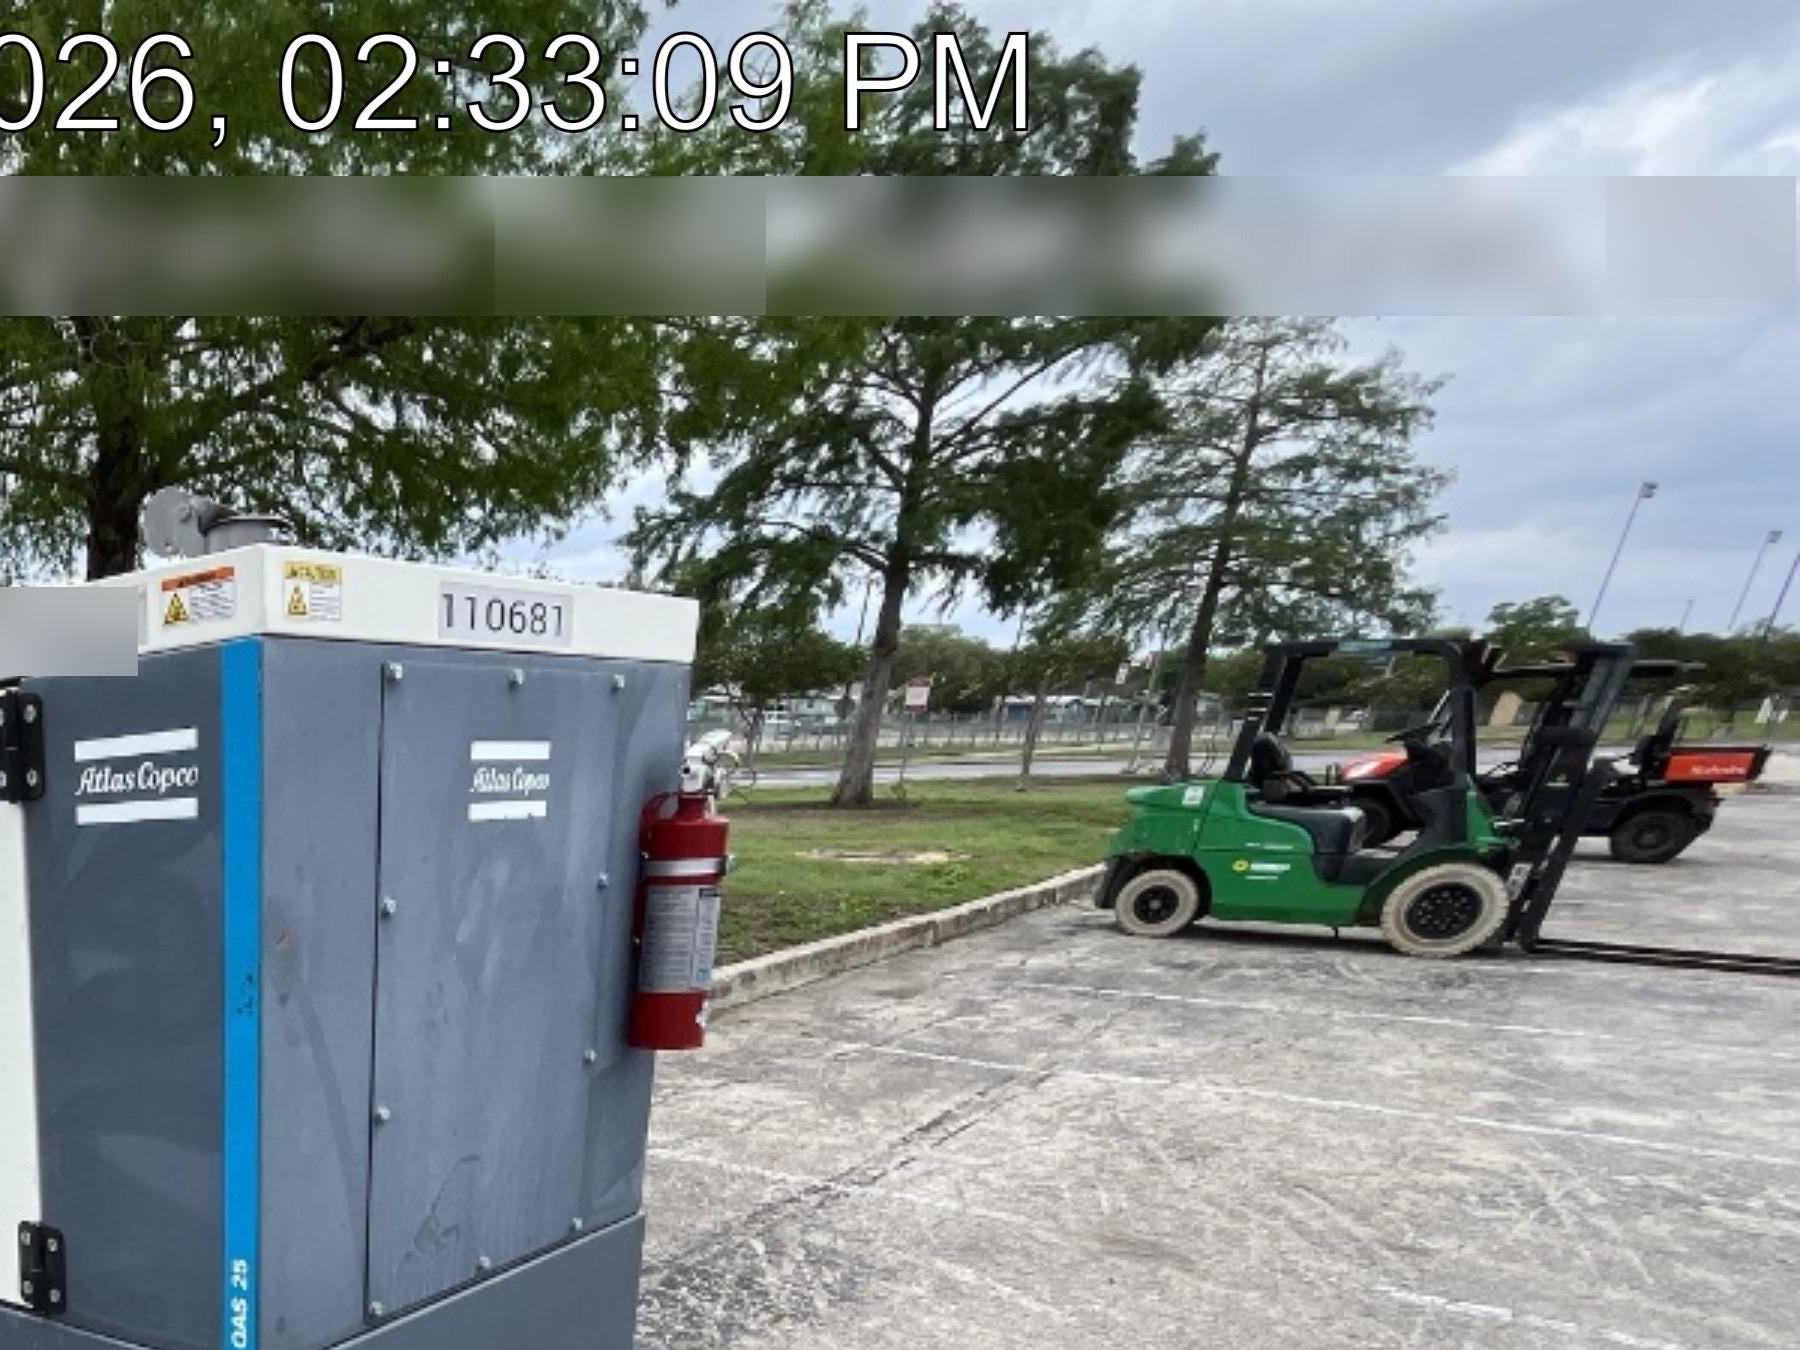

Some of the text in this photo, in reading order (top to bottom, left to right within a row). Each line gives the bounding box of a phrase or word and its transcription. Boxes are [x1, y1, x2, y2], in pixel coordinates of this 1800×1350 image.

[440, 592, 563, 637] 110681
[74, 761, 199, 796] Atlas Copco
[230, 1259, 248, 1350] QAS 25
